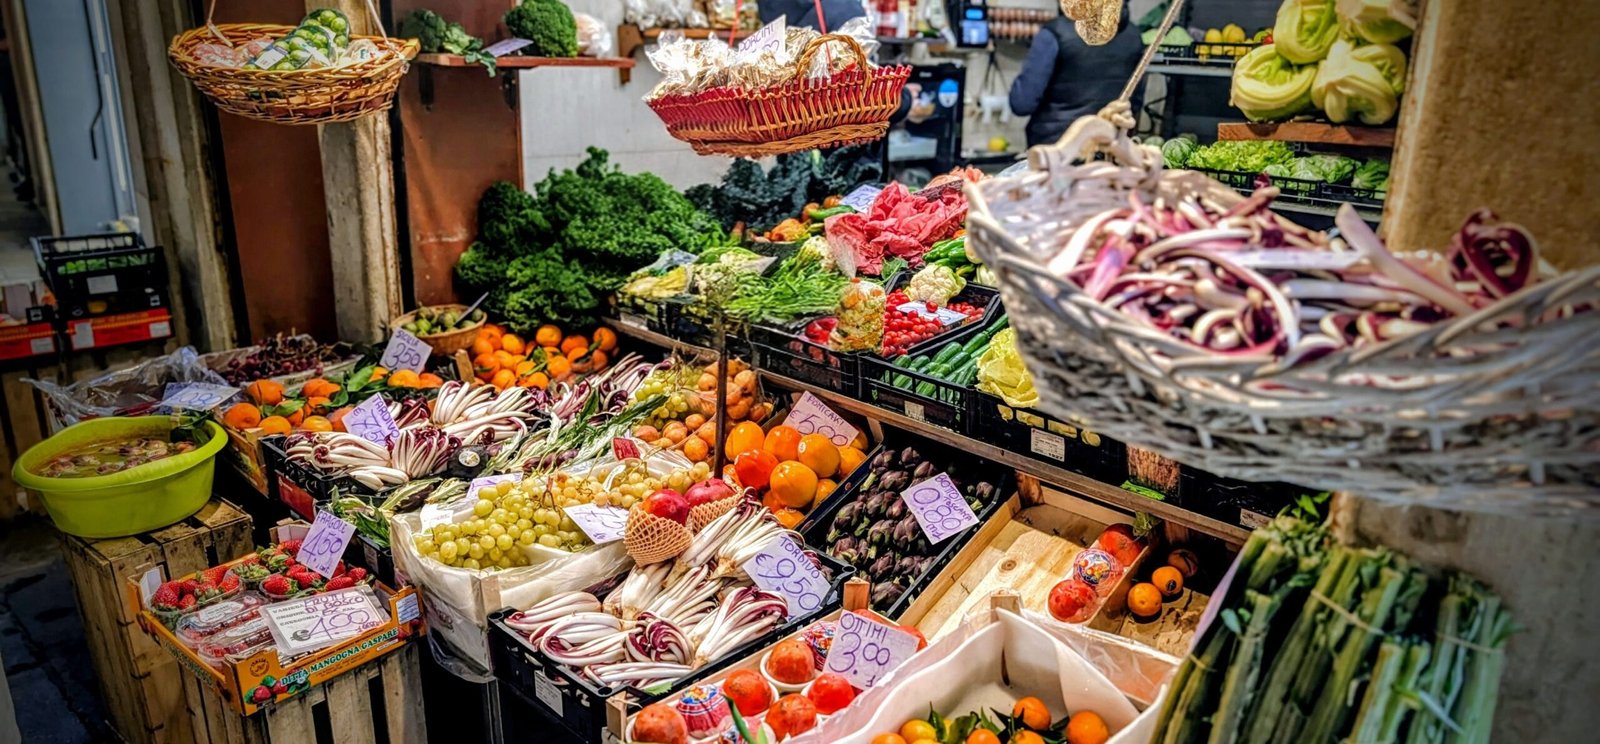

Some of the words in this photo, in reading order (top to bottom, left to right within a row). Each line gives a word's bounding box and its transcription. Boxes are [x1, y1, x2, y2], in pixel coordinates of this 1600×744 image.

[372, 393, 400, 438] TARDIVO
[317, 511, 348, 534] FRAGOLE
[913, 487, 962, 530] 0.80
[780, 536, 820, 578] TORDIVO
[305, 606, 319, 614] DI
[323, 596, 364, 611] BOSCO
[280, 668, 310, 686] DITTA
[309, 645, 361, 674] MANGOGNA
[360, 627, 399, 650] GASPARE
